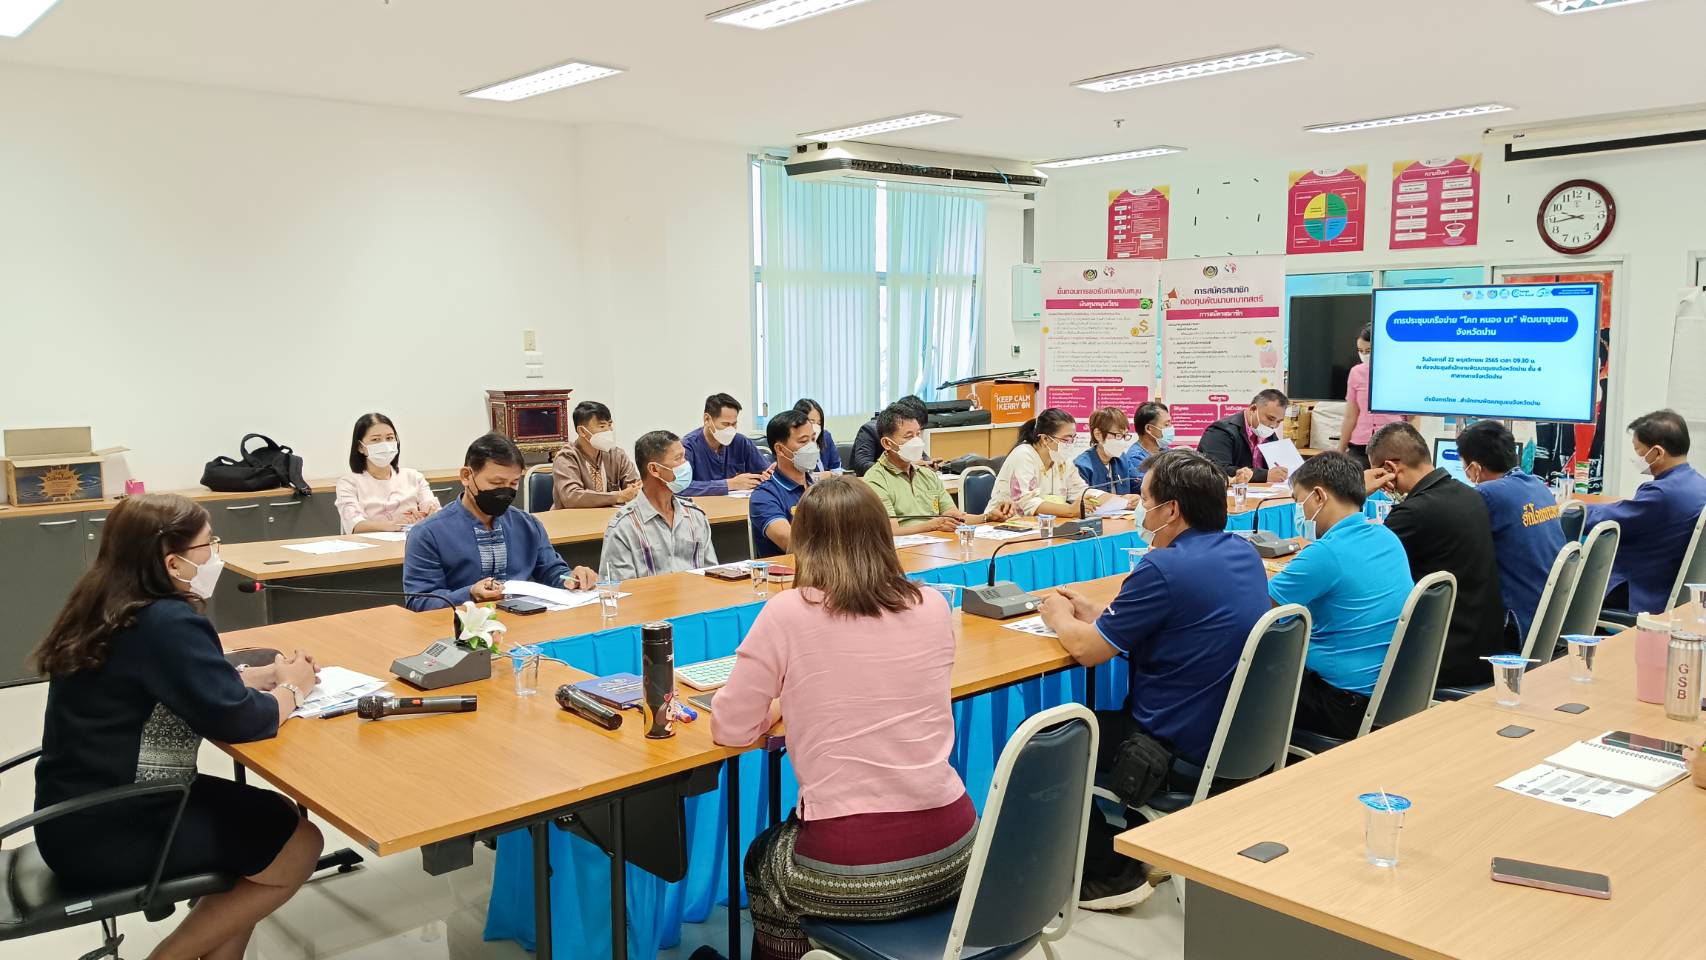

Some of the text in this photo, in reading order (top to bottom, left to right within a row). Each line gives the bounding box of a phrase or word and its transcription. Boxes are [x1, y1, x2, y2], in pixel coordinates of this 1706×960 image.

[1057, 286, 1142, 296] ขั้นตอนการขอรับเงินสนับสนุน
[1194, 285, 1249, 295] การสมัครสมาชิก
[1180, 294, 1264, 306] กองทุนพัฒนาบทบาทสตรี
[1393, 315, 1458, 327] การประชุมเครือข่าย
[1519, 315, 1569, 325] พัฒนาชุมชน
[1456, 327, 1497, 336] จังหวัดน่าน
[998, 401, 1031, 411] KERRY ON
[1677, 664, 1689, 700] GSB
